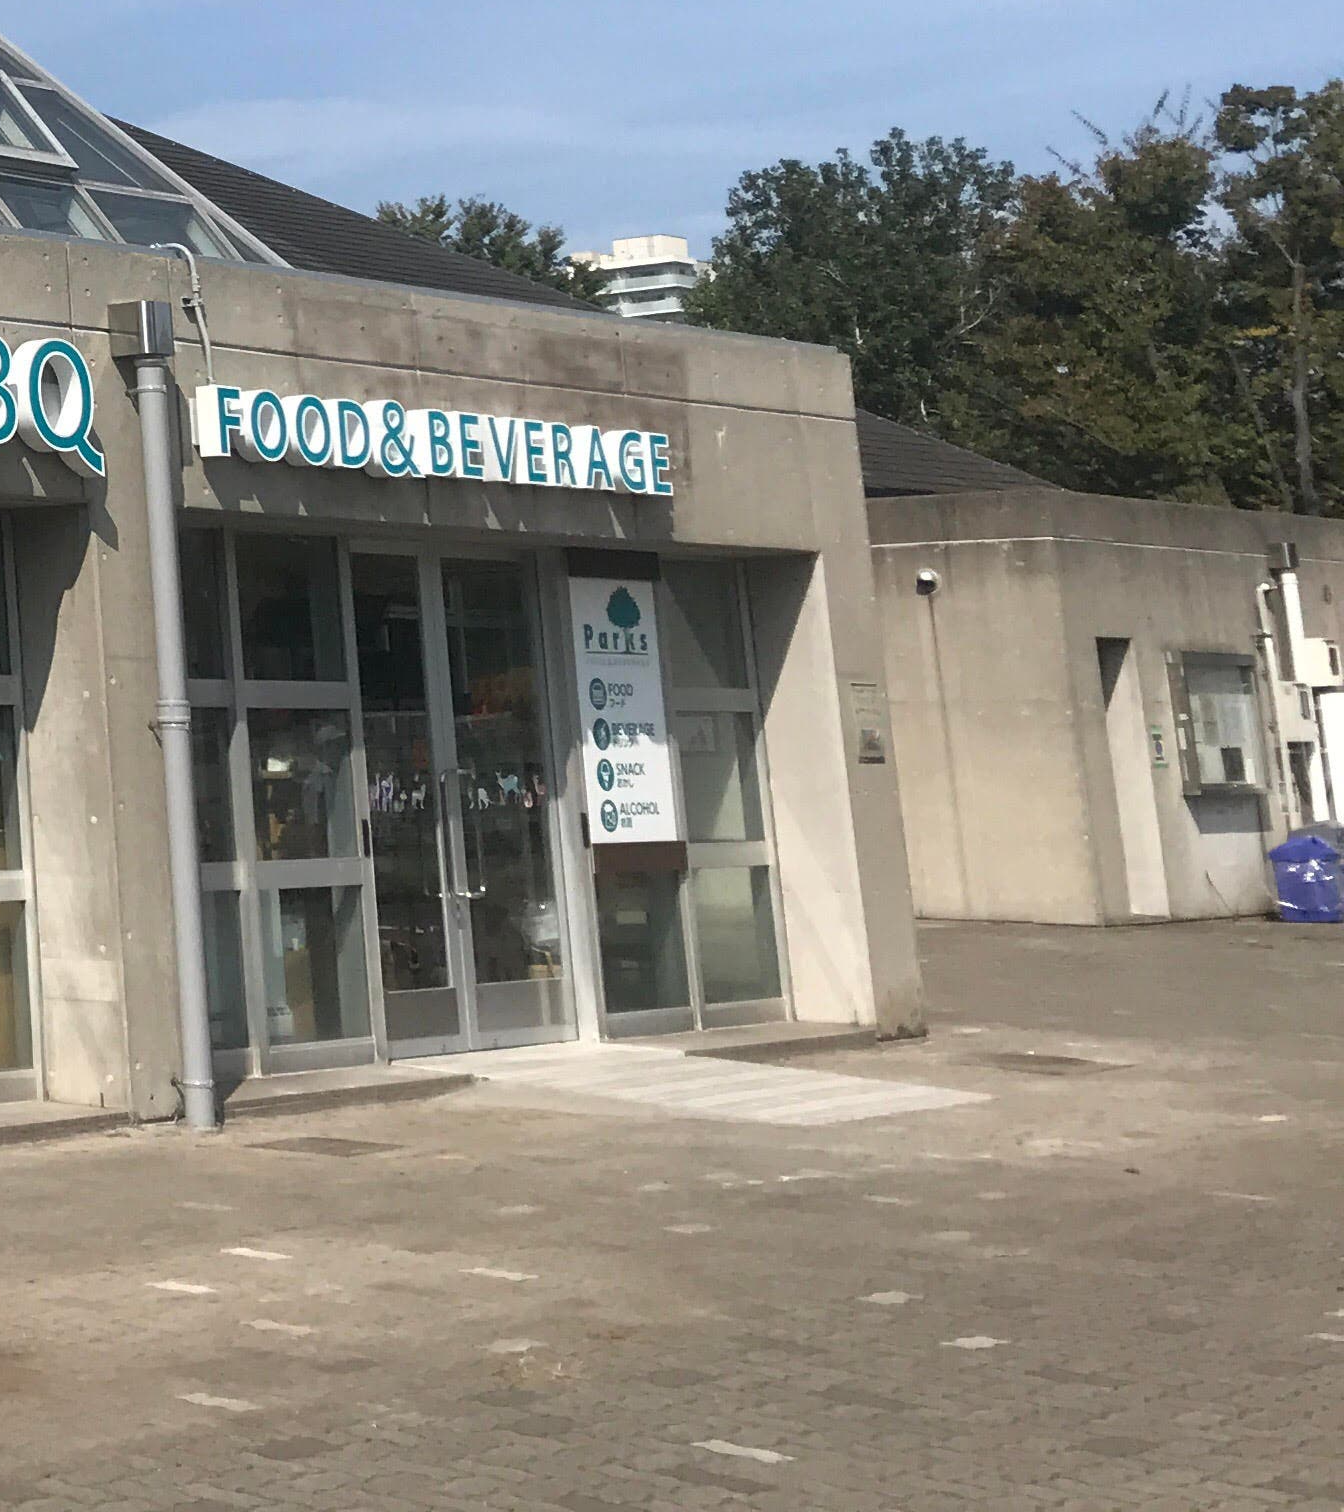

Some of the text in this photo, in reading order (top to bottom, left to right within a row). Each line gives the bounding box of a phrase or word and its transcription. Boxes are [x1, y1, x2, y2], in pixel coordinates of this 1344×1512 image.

[196, 385, 674, 495] FOOD&BEVERAGE
[583, 623, 648, 651] Parks
[608, 682, 634, 696] FOOD
[615, 762, 647, 776] SNACK
[620, 801, 660, 816] ALCOHOL
